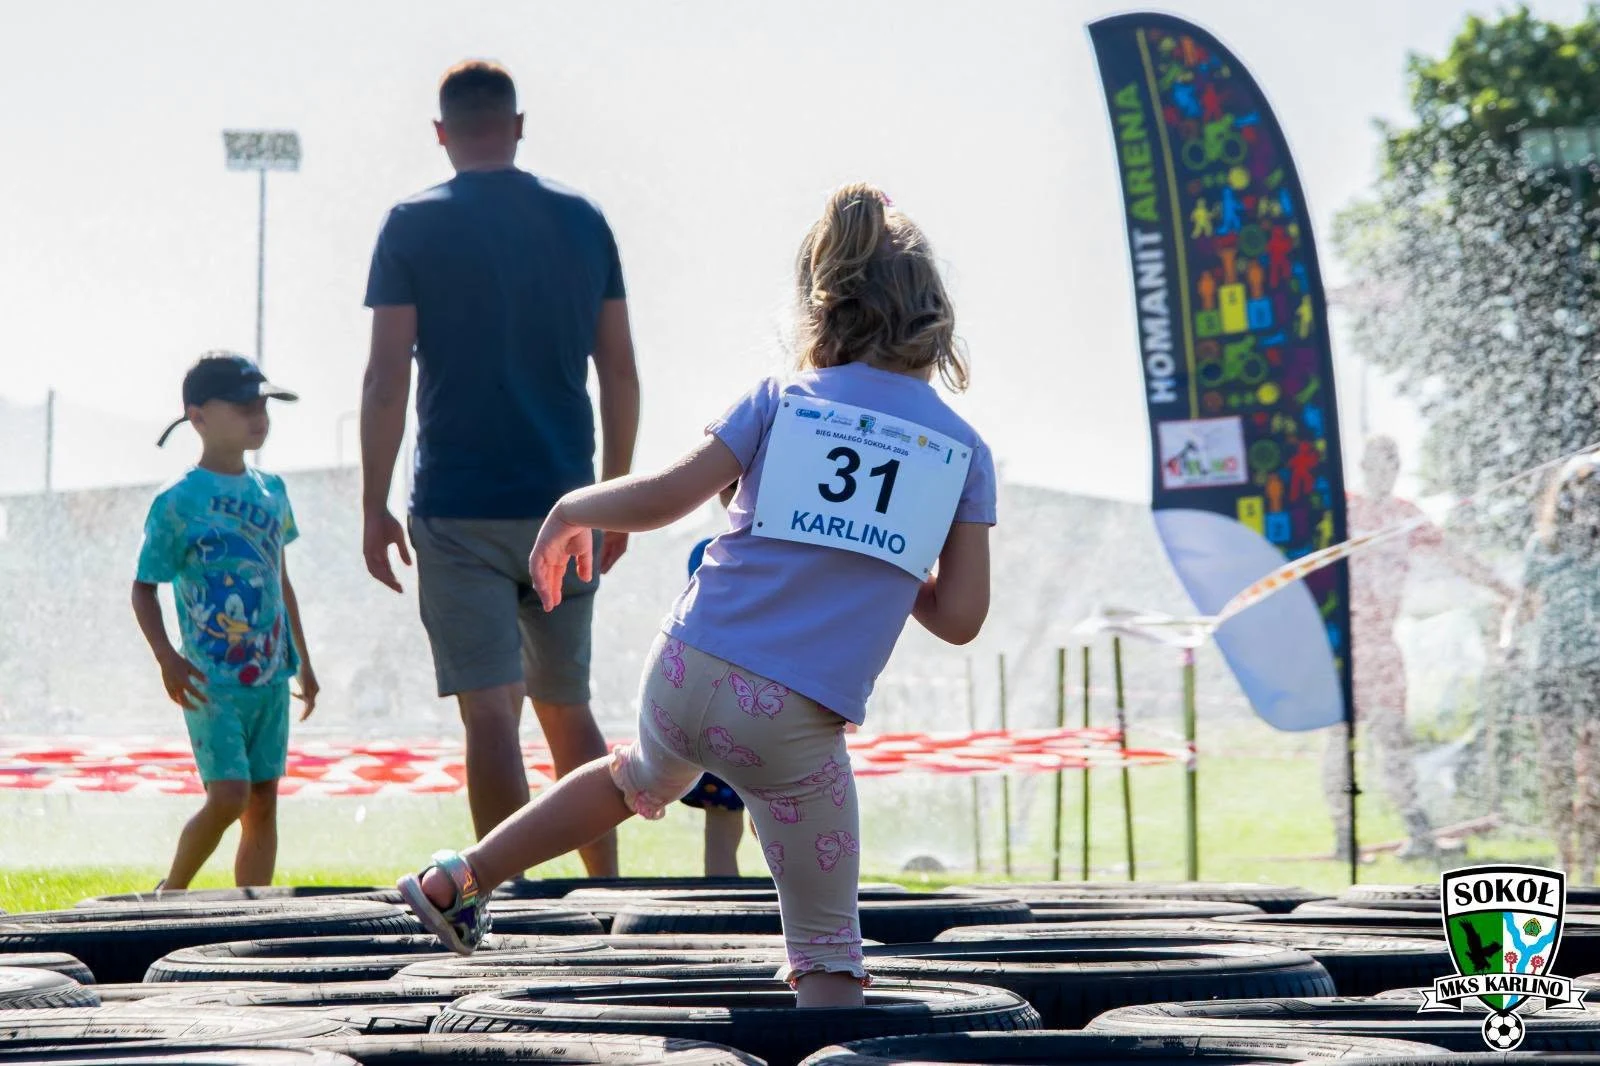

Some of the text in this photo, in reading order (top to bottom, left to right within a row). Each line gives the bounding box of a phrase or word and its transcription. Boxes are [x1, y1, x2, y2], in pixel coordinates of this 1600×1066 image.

[1114, 82, 1178, 403] HOMANIT ARENA
[815, 428, 831, 437] BIEG
[818, 446, 901, 515] 31
[790, 510, 906, 555] KARLINO
